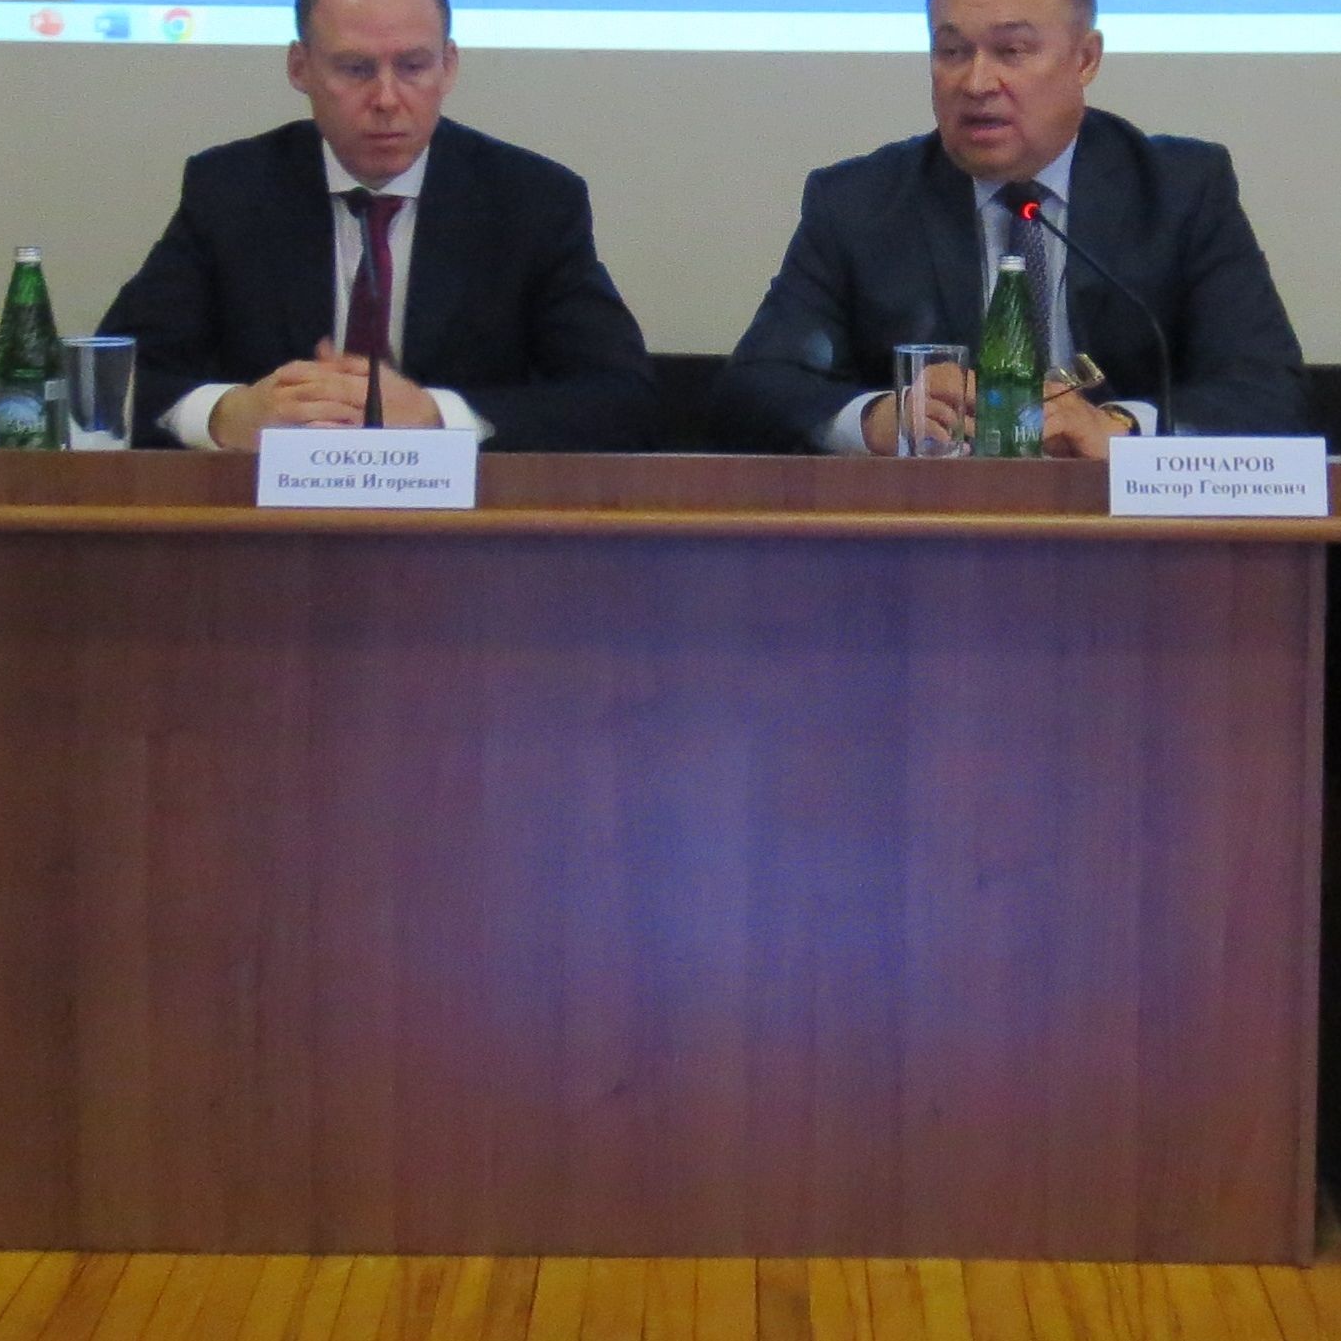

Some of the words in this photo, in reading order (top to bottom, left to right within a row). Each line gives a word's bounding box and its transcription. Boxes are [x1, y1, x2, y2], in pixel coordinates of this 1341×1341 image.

[309, 450, 420, 467] СОКОЛОВ
[1156, 456, 1275, 472] ГОНЧАРОВ
[277, 473, 356, 489] Василий
[361, 473, 451, 493] Игоревич
[1125, 479, 1194, 499] Виктор
[1199, 479, 1306, 499] Георгиевич
